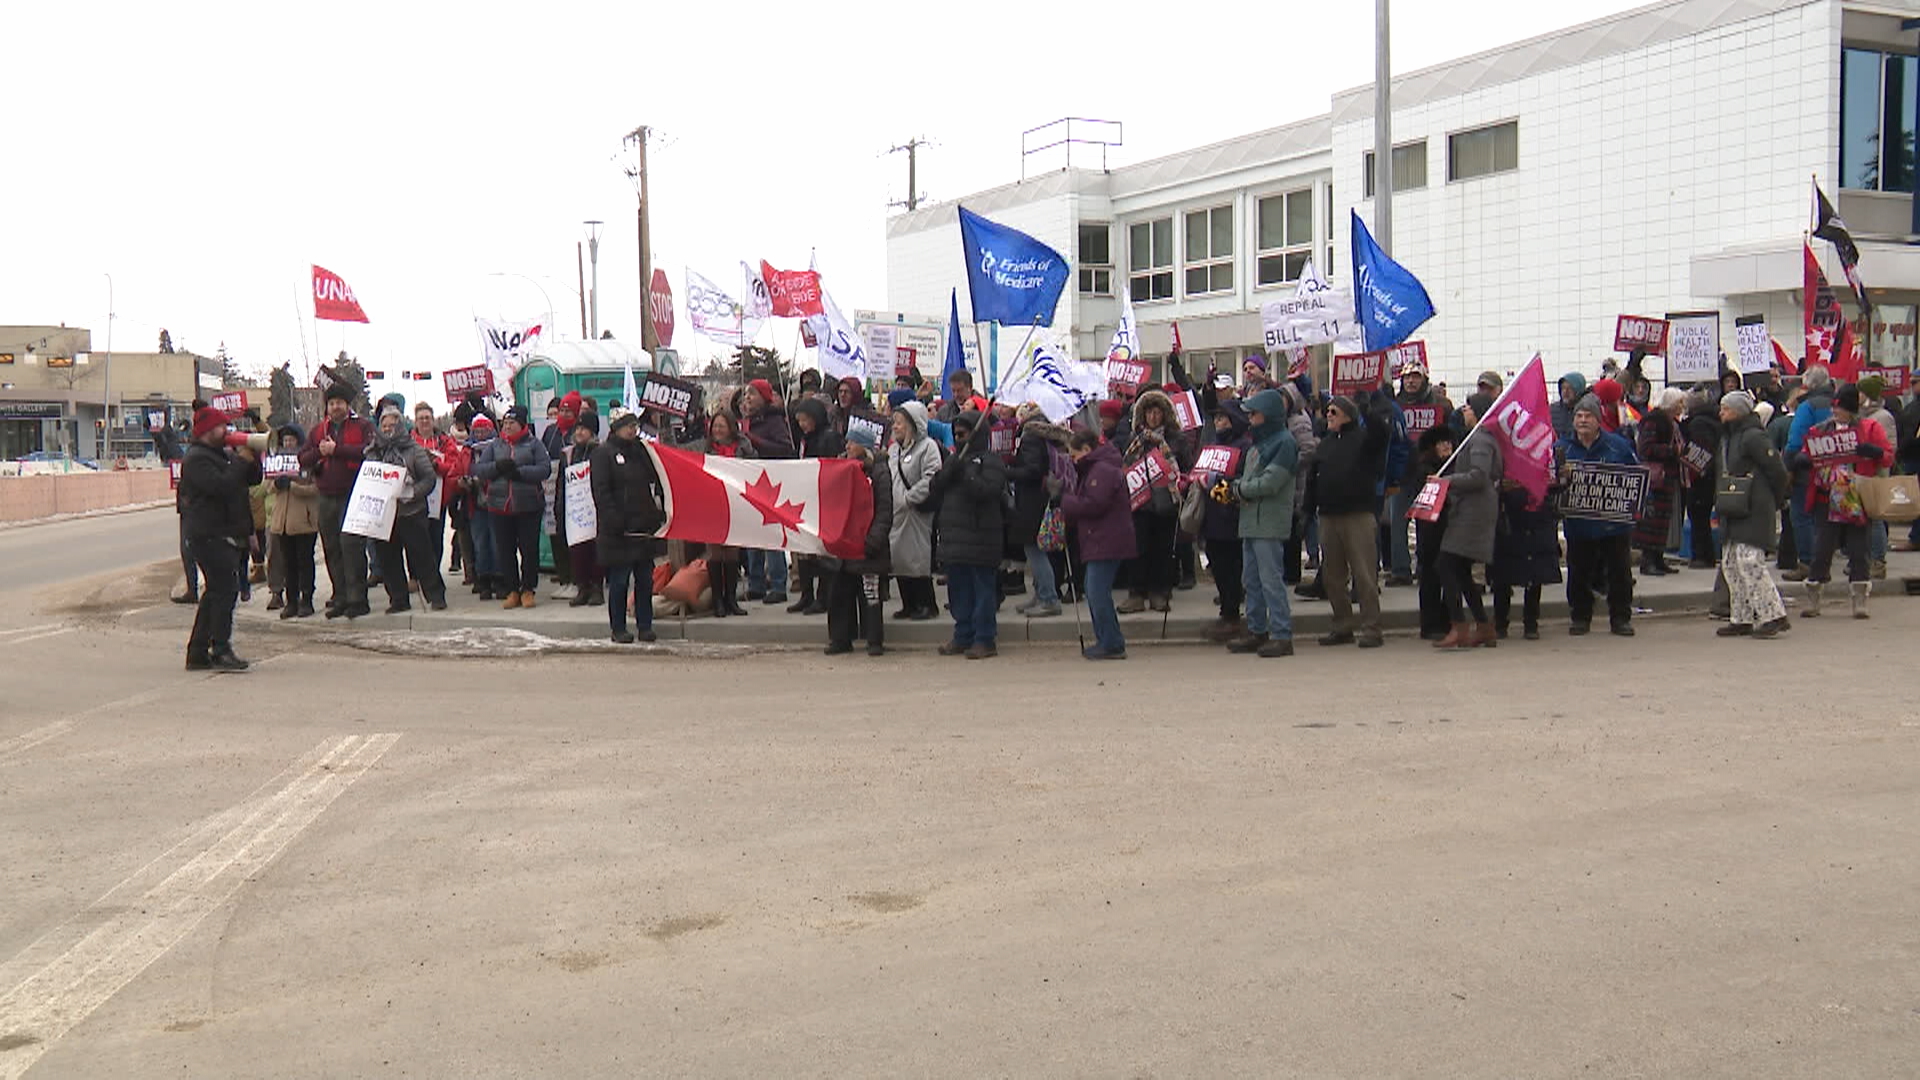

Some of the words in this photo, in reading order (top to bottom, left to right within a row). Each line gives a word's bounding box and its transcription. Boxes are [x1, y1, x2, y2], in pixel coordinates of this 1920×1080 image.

[1038, 259, 1052, 271] of
[995, 271, 1044, 288] Medicare
[651, 292, 673, 324] STOP
[1280, 297, 1326, 315] REPEAL
[1265, 327, 1302, 346] BILL
[1320, 319, 1340, 336] 11
[1620, 319, 1647, 341] NO
[1110, 361, 1123, 378] NO
[1337, 358, 1365, 380] NO
[446, 371, 468, 391] NO
[643, 381, 669, 405] NO
[671, 388, 691, 402] TWO
[668, 399, 689, 412] TIER
[1415, 409, 1435, 420] TWO
[1807, 436, 1835, 456] NO
[1834, 431, 1857, 442] TWO
[266, 455, 283, 472] NO
[1196, 448, 1214, 469] NO
[363, 467, 382, 478] UNA
[1572, 471, 1594, 484] ON'T
[1595, 473, 1618, 487] PULL
[1621, 476, 1640, 488] THE
[1589, 485, 1603, 497] ON
[1604, 487, 1639, 501] PUBLIC
[1568, 494, 1603, 511] HEALTH
[1604, 499, 1630, 512] CARE
